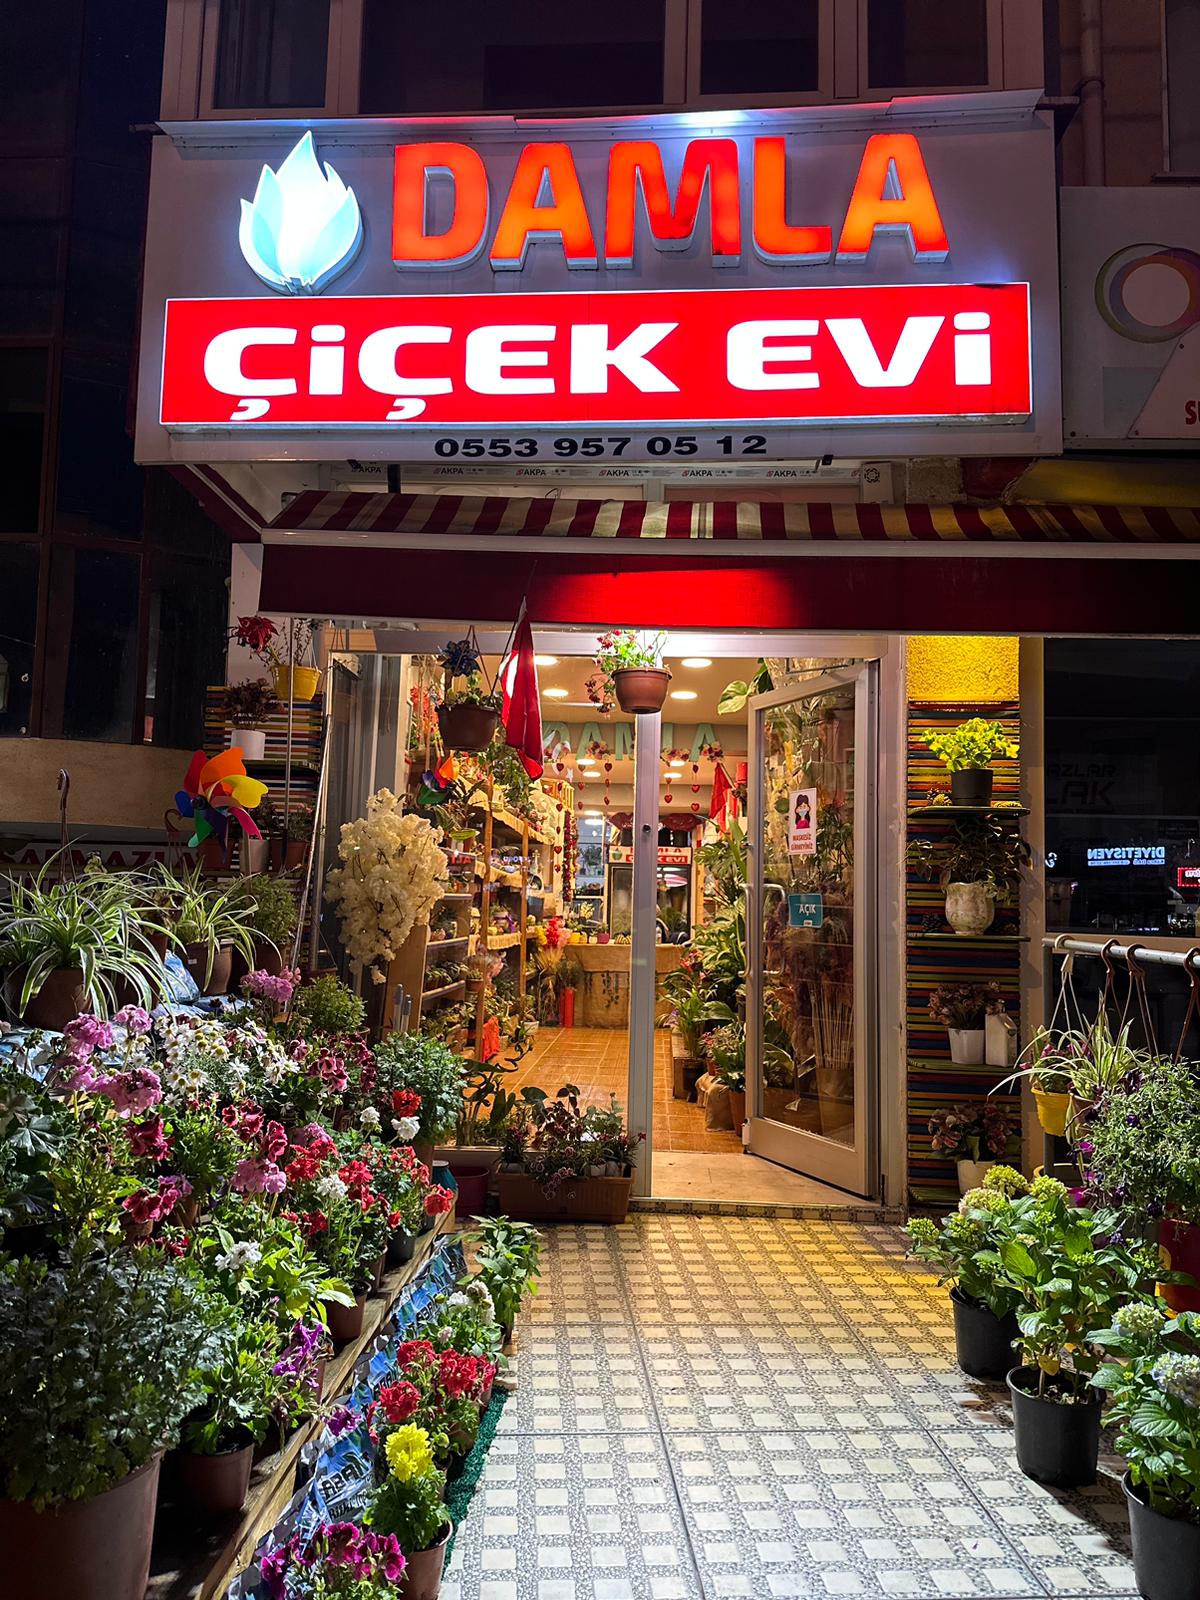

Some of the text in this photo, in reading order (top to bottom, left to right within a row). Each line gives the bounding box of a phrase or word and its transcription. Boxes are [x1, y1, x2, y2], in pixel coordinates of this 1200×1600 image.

[392, 134, 949, 270] DAMLA
[434, 435, 767, 458] 0553 957 05 12
[440, 467, 464, 475] AKPA
[523, 468, 546, 476] AKPA
[606, 469, 630, 477] AKPA
[689, 469, 713, 477] AKPA
[773, 470, 797, 478] AKPA
[799, 904, 816, 916] AÇIK
